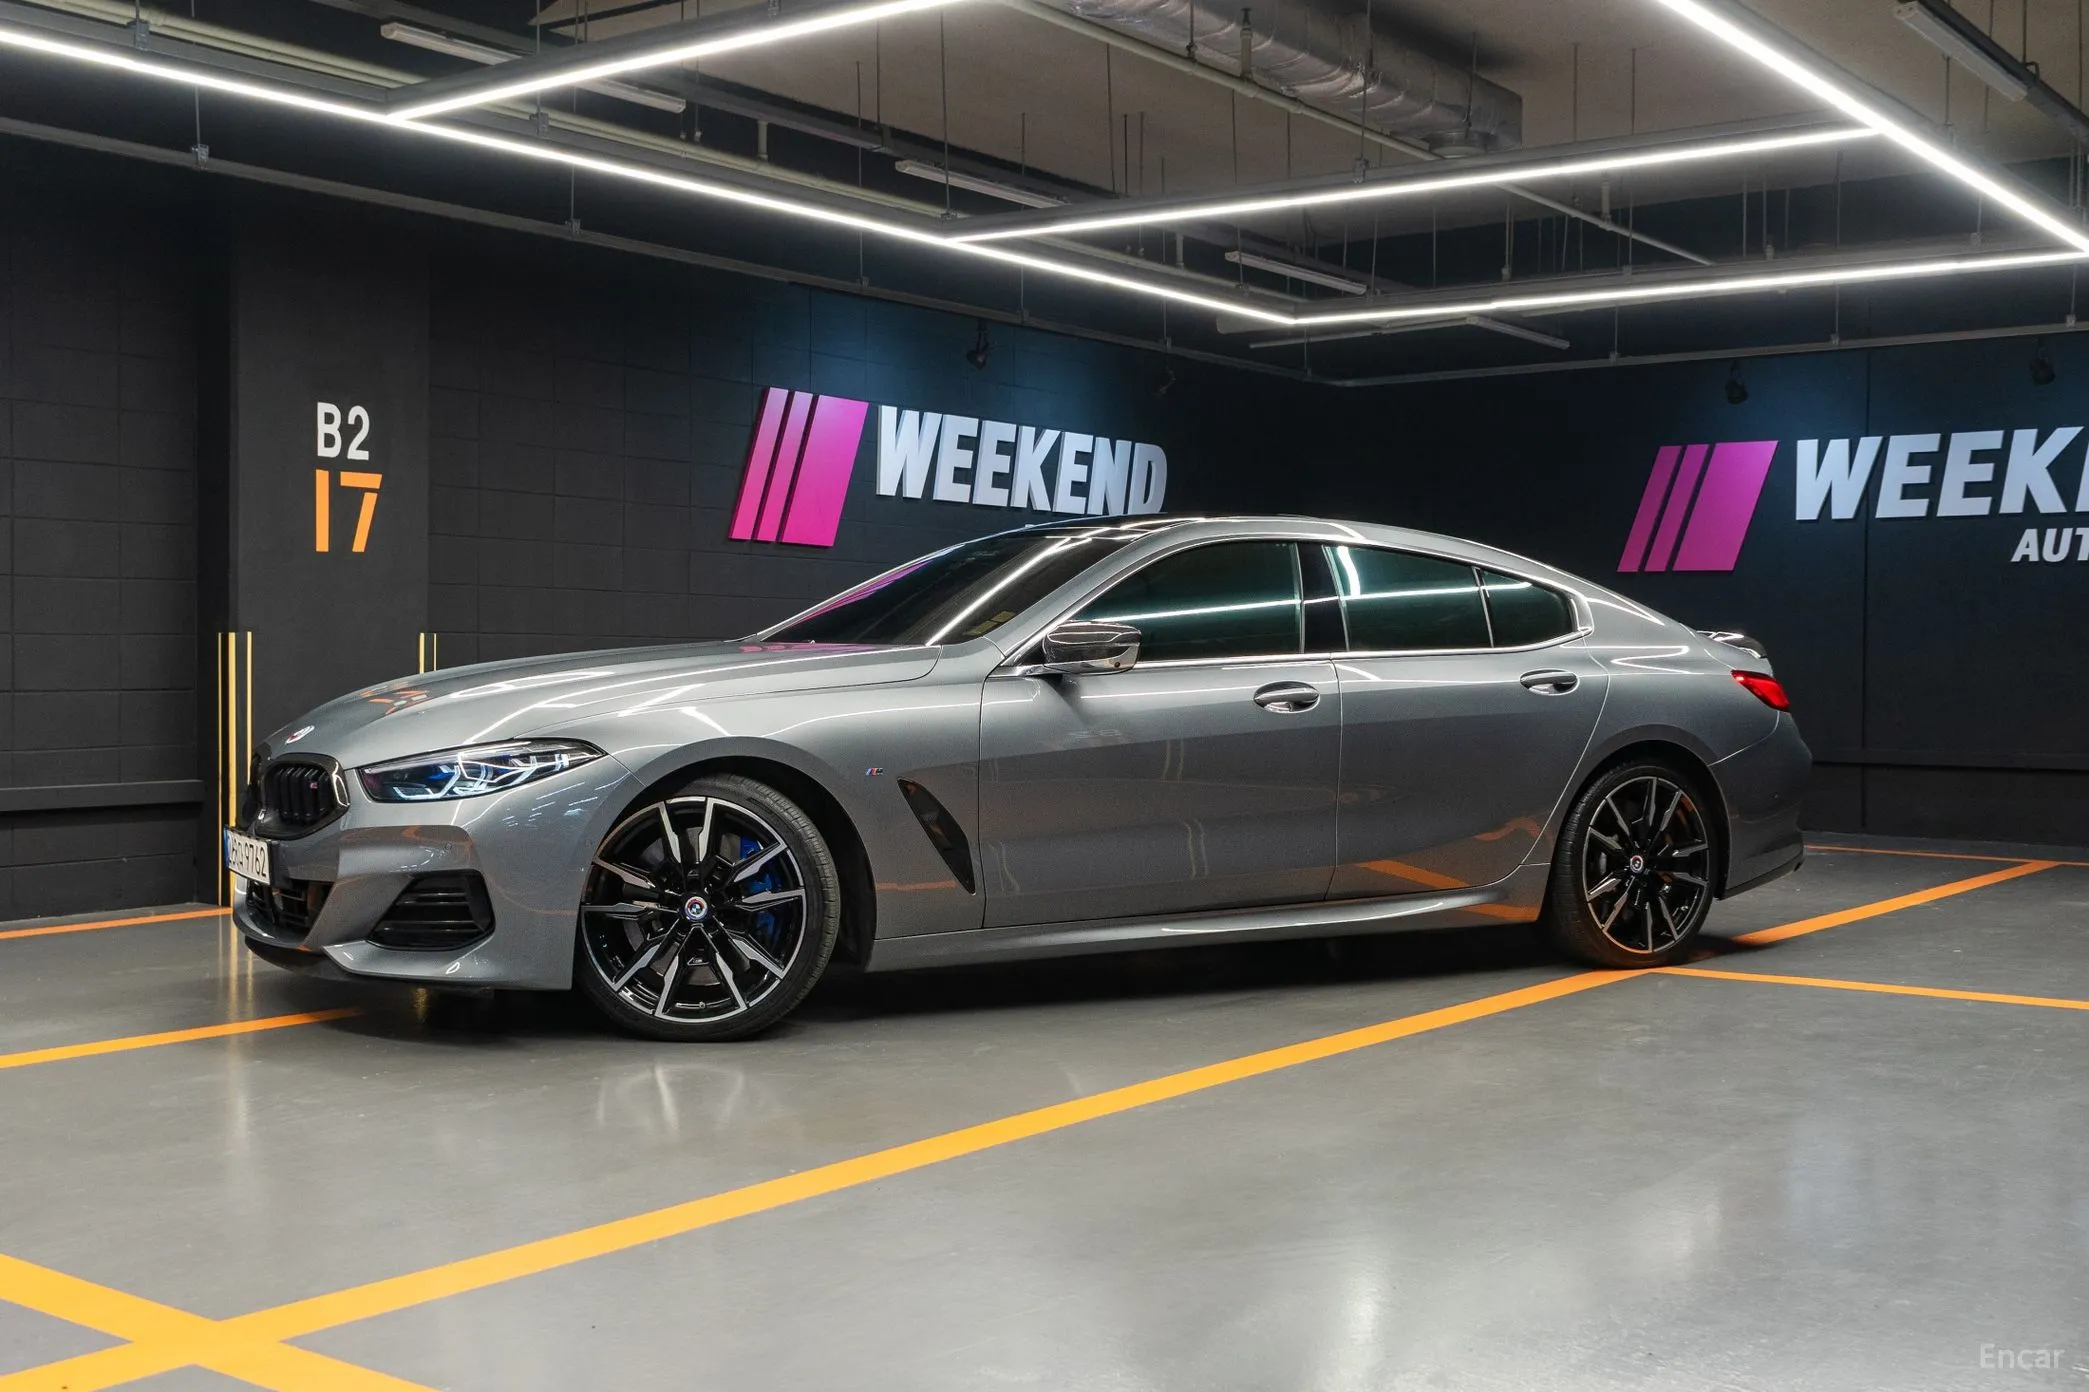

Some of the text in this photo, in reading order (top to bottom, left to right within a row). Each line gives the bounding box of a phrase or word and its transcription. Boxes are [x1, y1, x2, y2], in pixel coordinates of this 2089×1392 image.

[317, 402, 370, 461] B2
[876, 404, 1168, 515] WEEKEND
[1795, 426, 2089, 521] WEEK
[315, 468, 383, 553] 17
